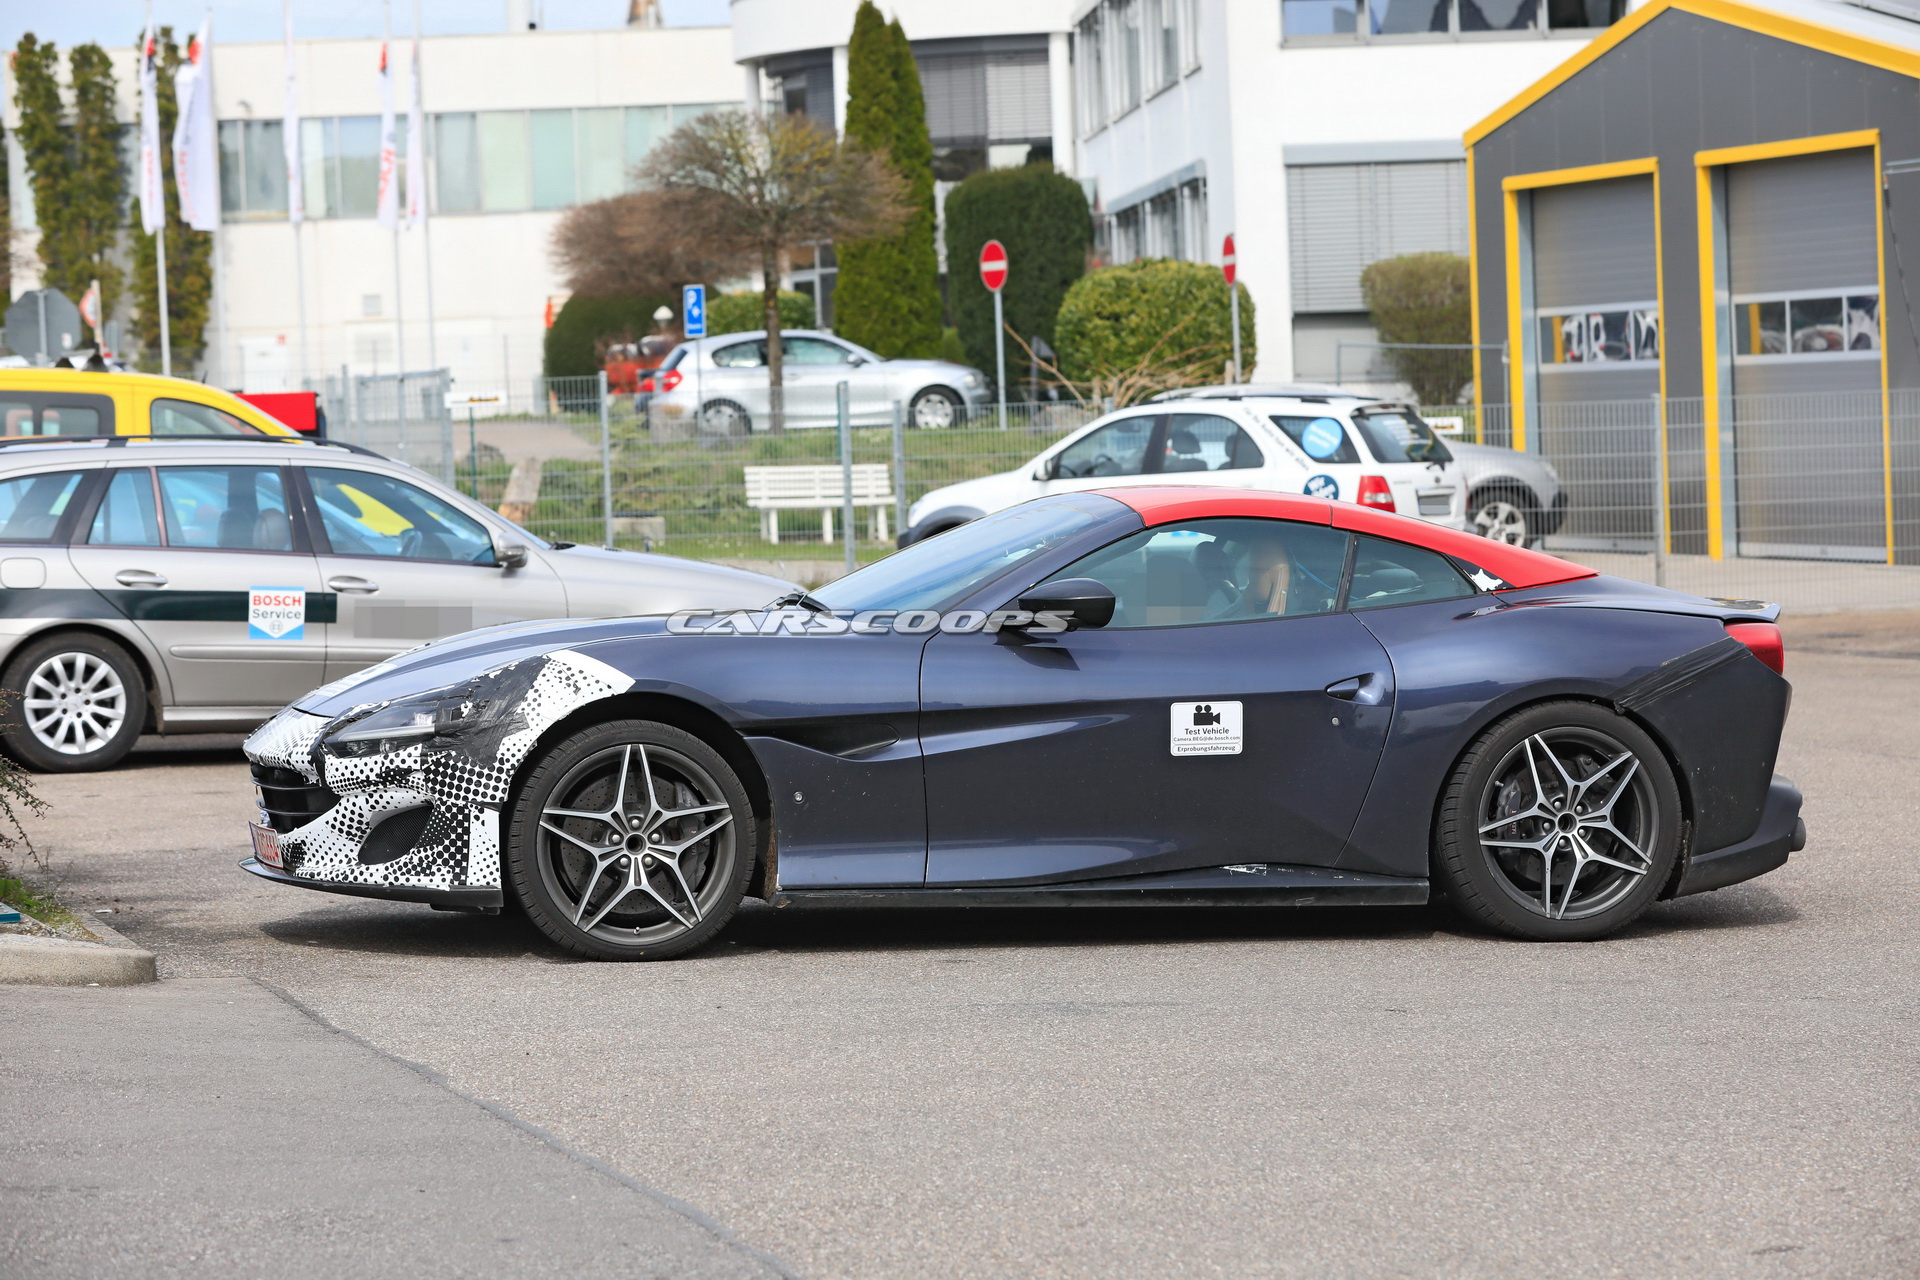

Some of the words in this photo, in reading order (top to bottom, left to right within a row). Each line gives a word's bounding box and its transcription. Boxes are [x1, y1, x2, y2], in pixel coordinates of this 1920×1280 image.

[252, 595, 302, 606] BOSCH
[252, 608, 302, 619] Service
[1202, 727, 1230, 735] Vehicle
[1177, 745, 1236, 753] Erprobungsfahrzeug
